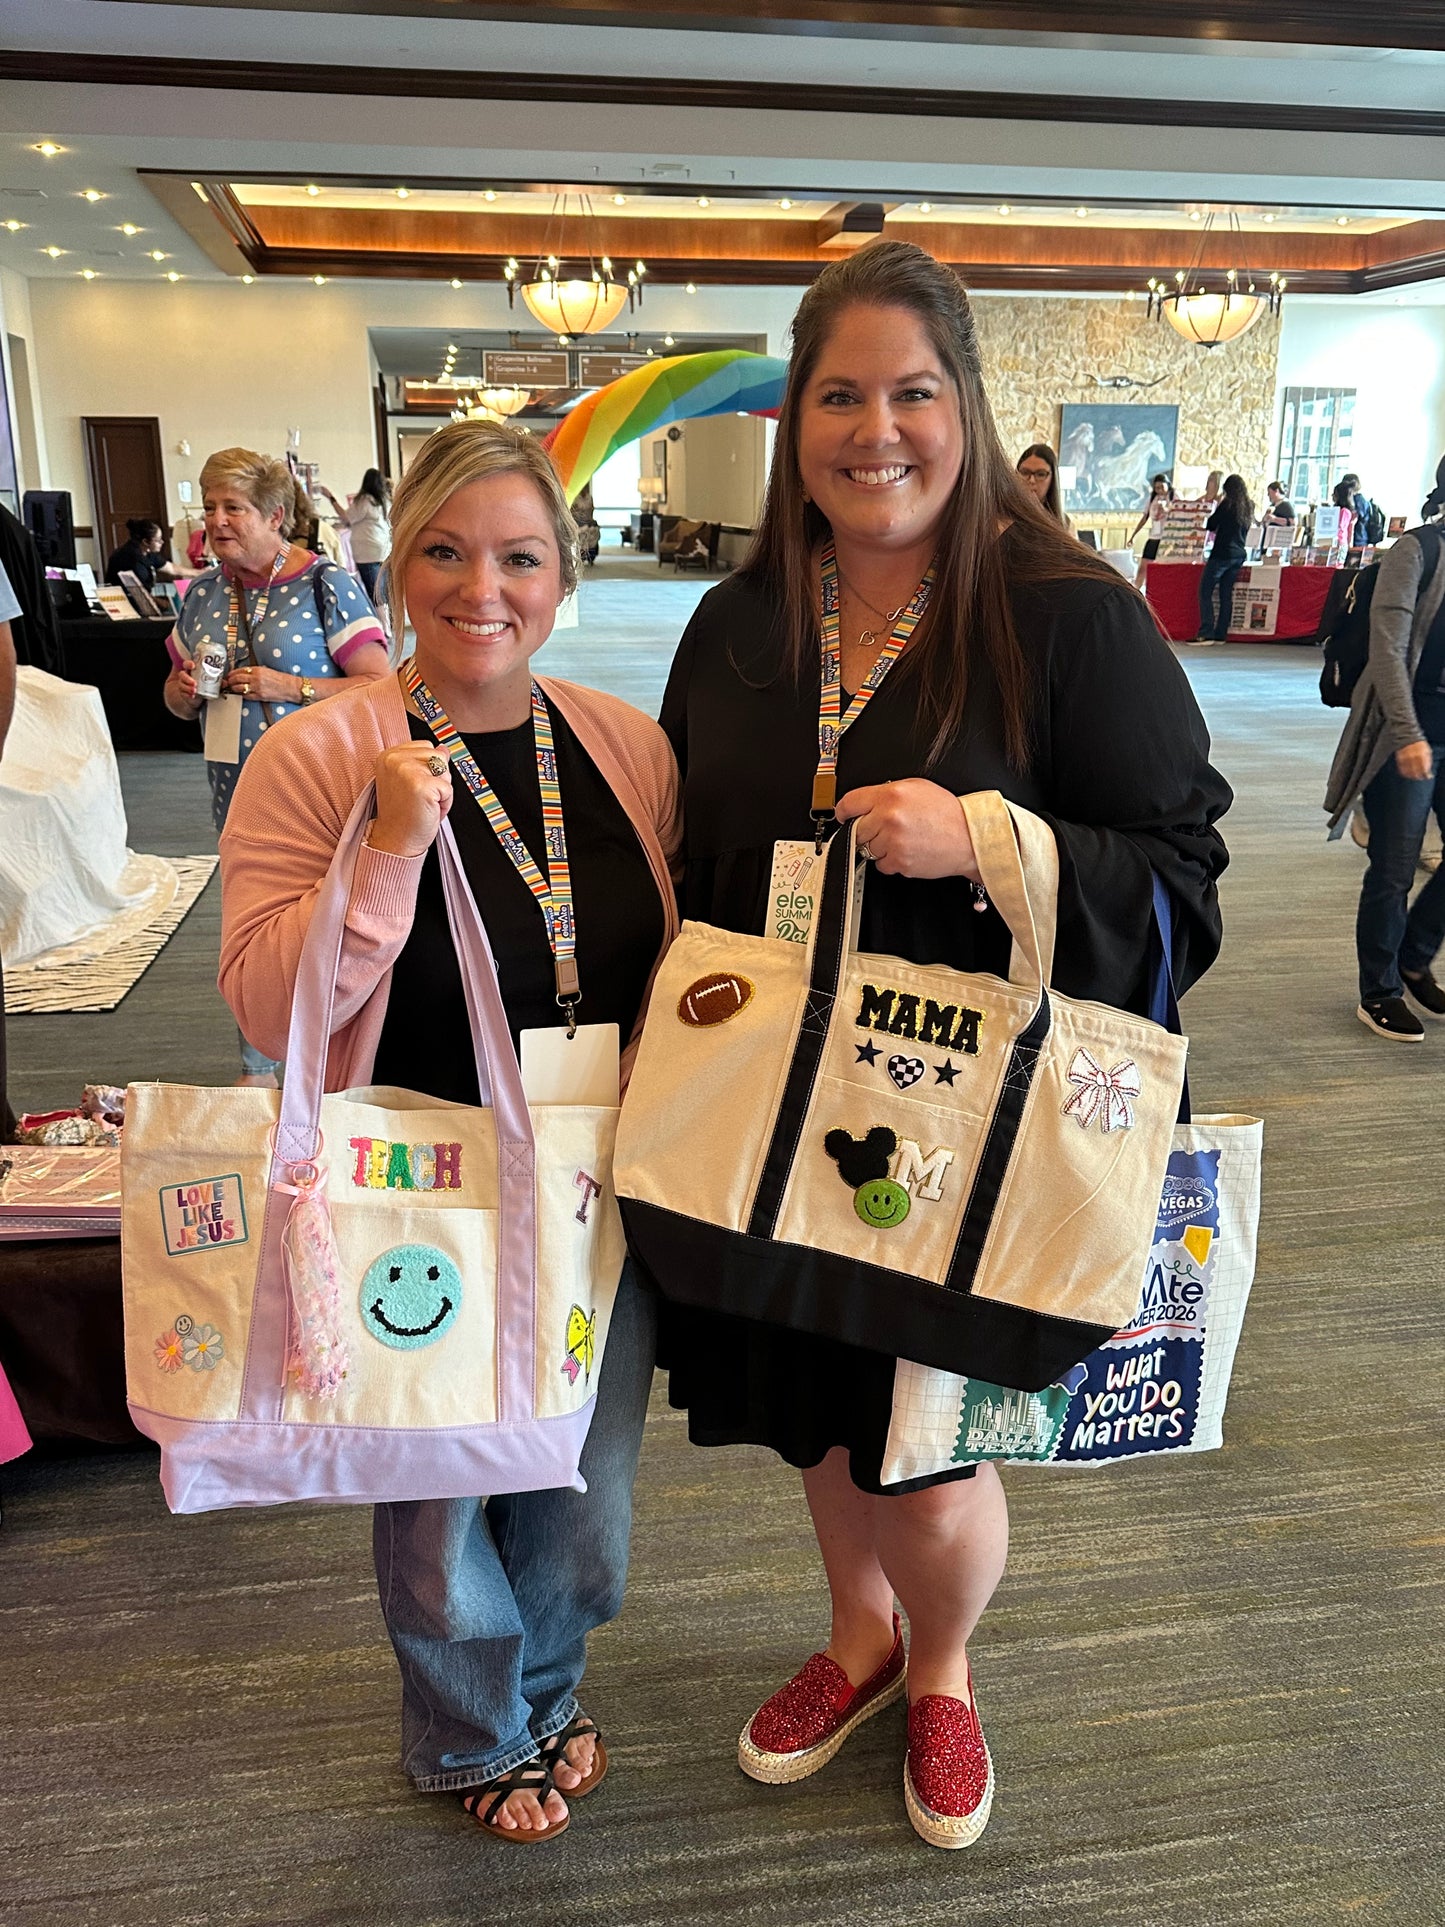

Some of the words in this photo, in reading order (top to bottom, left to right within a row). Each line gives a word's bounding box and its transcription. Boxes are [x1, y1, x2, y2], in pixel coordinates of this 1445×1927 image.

[856, 984, 982, 1055] MAMA
[349, 1136, 463, 1190] TEACH
[895, 1138, 956, 1203] M
[177, 1182, 225, 1207] LOVE
[575, 1169, 603, 1225] T
[1160, 1195, 1204, 1210] VEGAS
[183, 1202, 224, 1227] LIKE
[176, 1219, 235, 1248] JESUS
[1124, 1307, 1156, 1329] MER
[1156, 1304, 1197, 1321] 2026
[1141, 1380, 1182, 1412] DO
[965, 1439, 1047, 1454] TEXAS
[967, 1429, 1052, 1447] DALLAS
